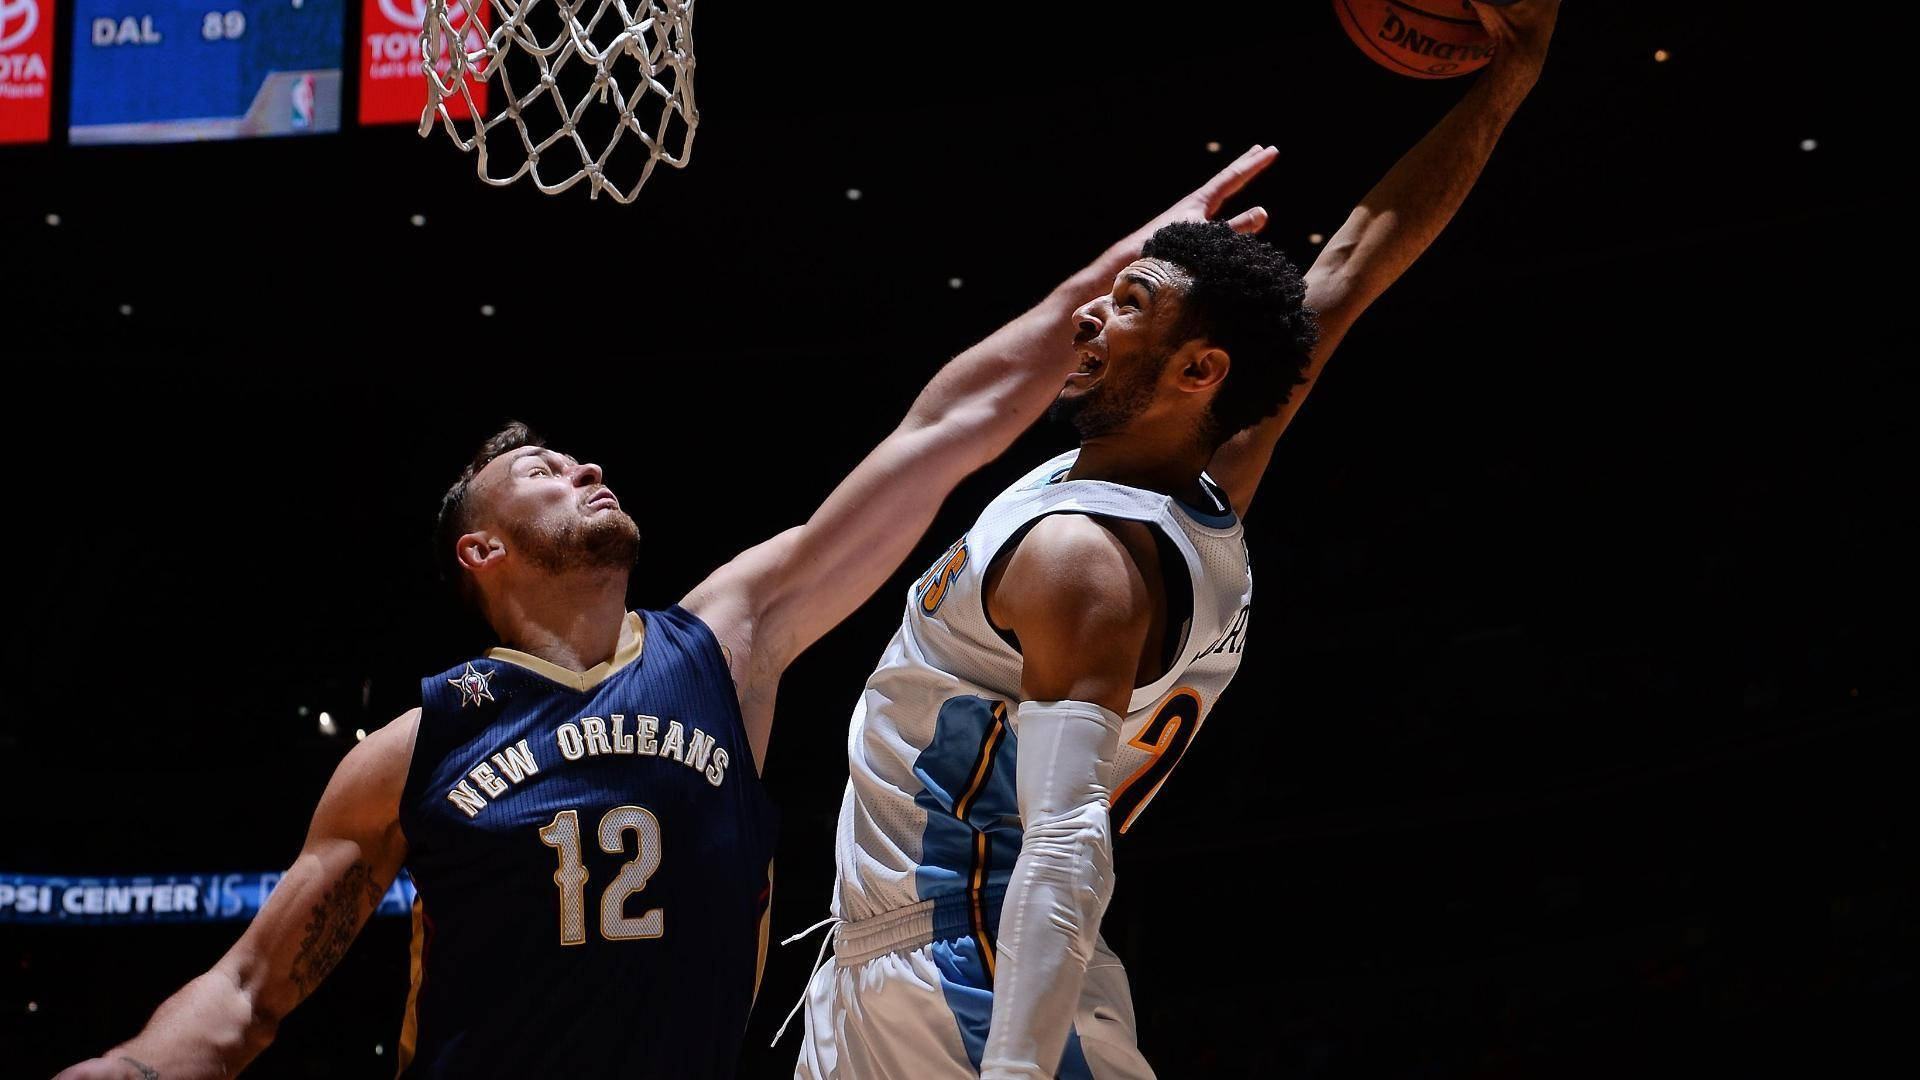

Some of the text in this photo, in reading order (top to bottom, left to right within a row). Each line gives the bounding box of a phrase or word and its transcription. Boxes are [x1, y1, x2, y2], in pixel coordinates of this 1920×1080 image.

[92, 11, 245, 46] DAL 89
[447, 714, 730, 818] NEW ORLEANS
[62, 883, 198, 914] CENTER
[538, 805, 664, 946] 12
